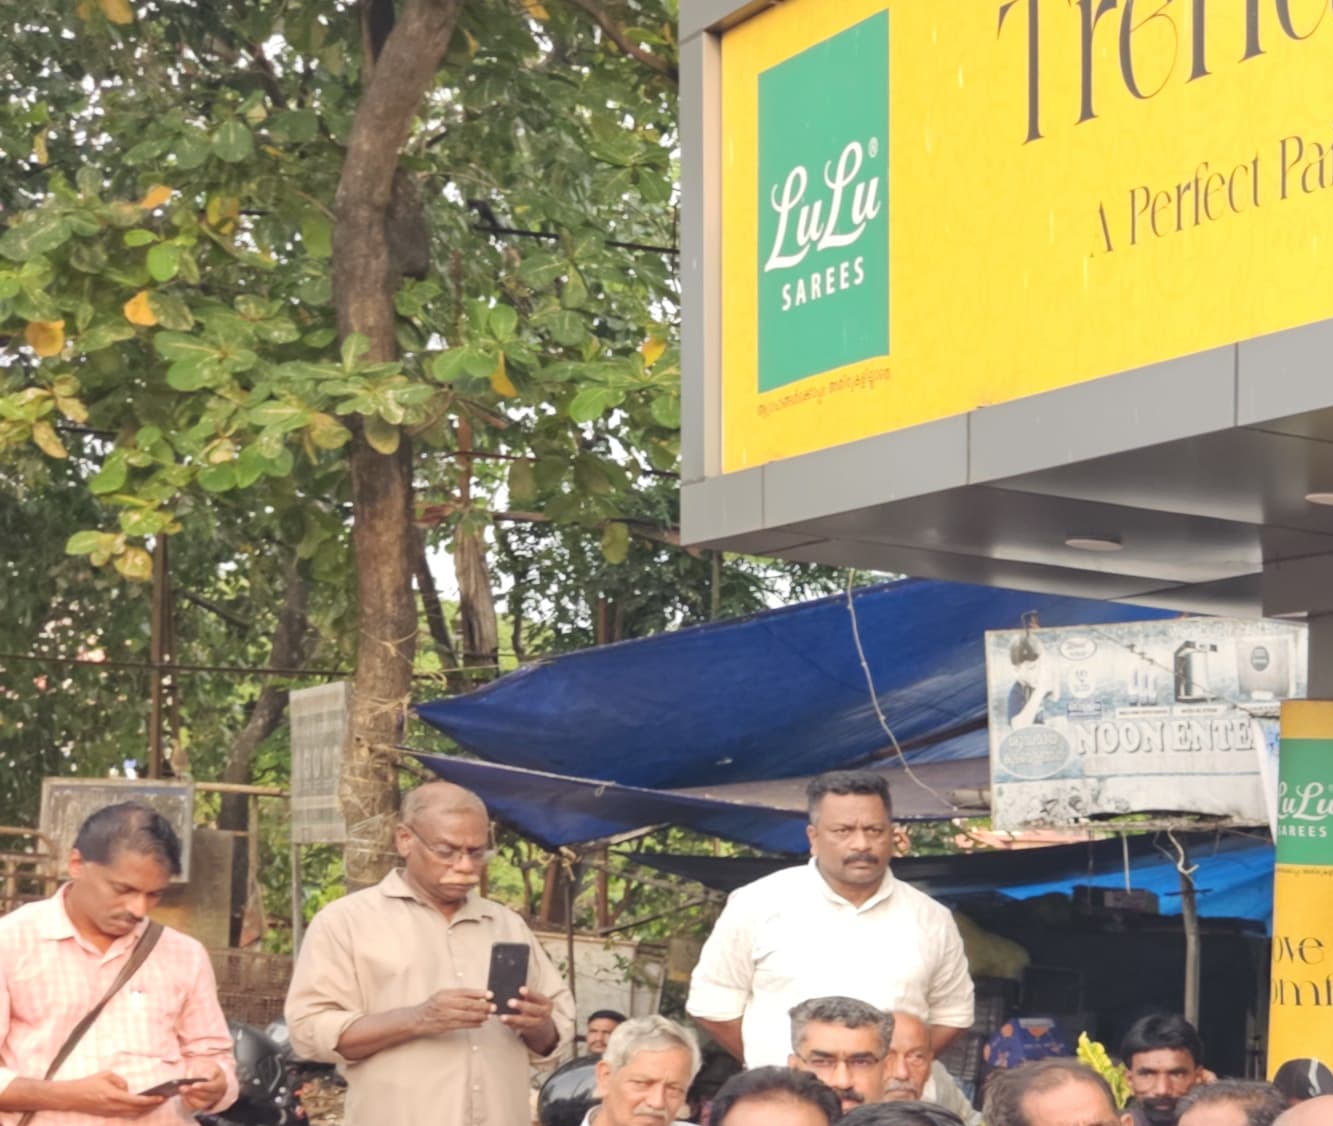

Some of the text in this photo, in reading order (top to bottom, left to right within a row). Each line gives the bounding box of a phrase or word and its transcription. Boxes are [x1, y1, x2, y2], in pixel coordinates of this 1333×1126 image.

[1089, 199, 1115, 259] A
[1128, 148, 1262, 246] Perfect
[781, 256, 865, 311] SAREES
[1075, 719, 1166, 756] NOON
